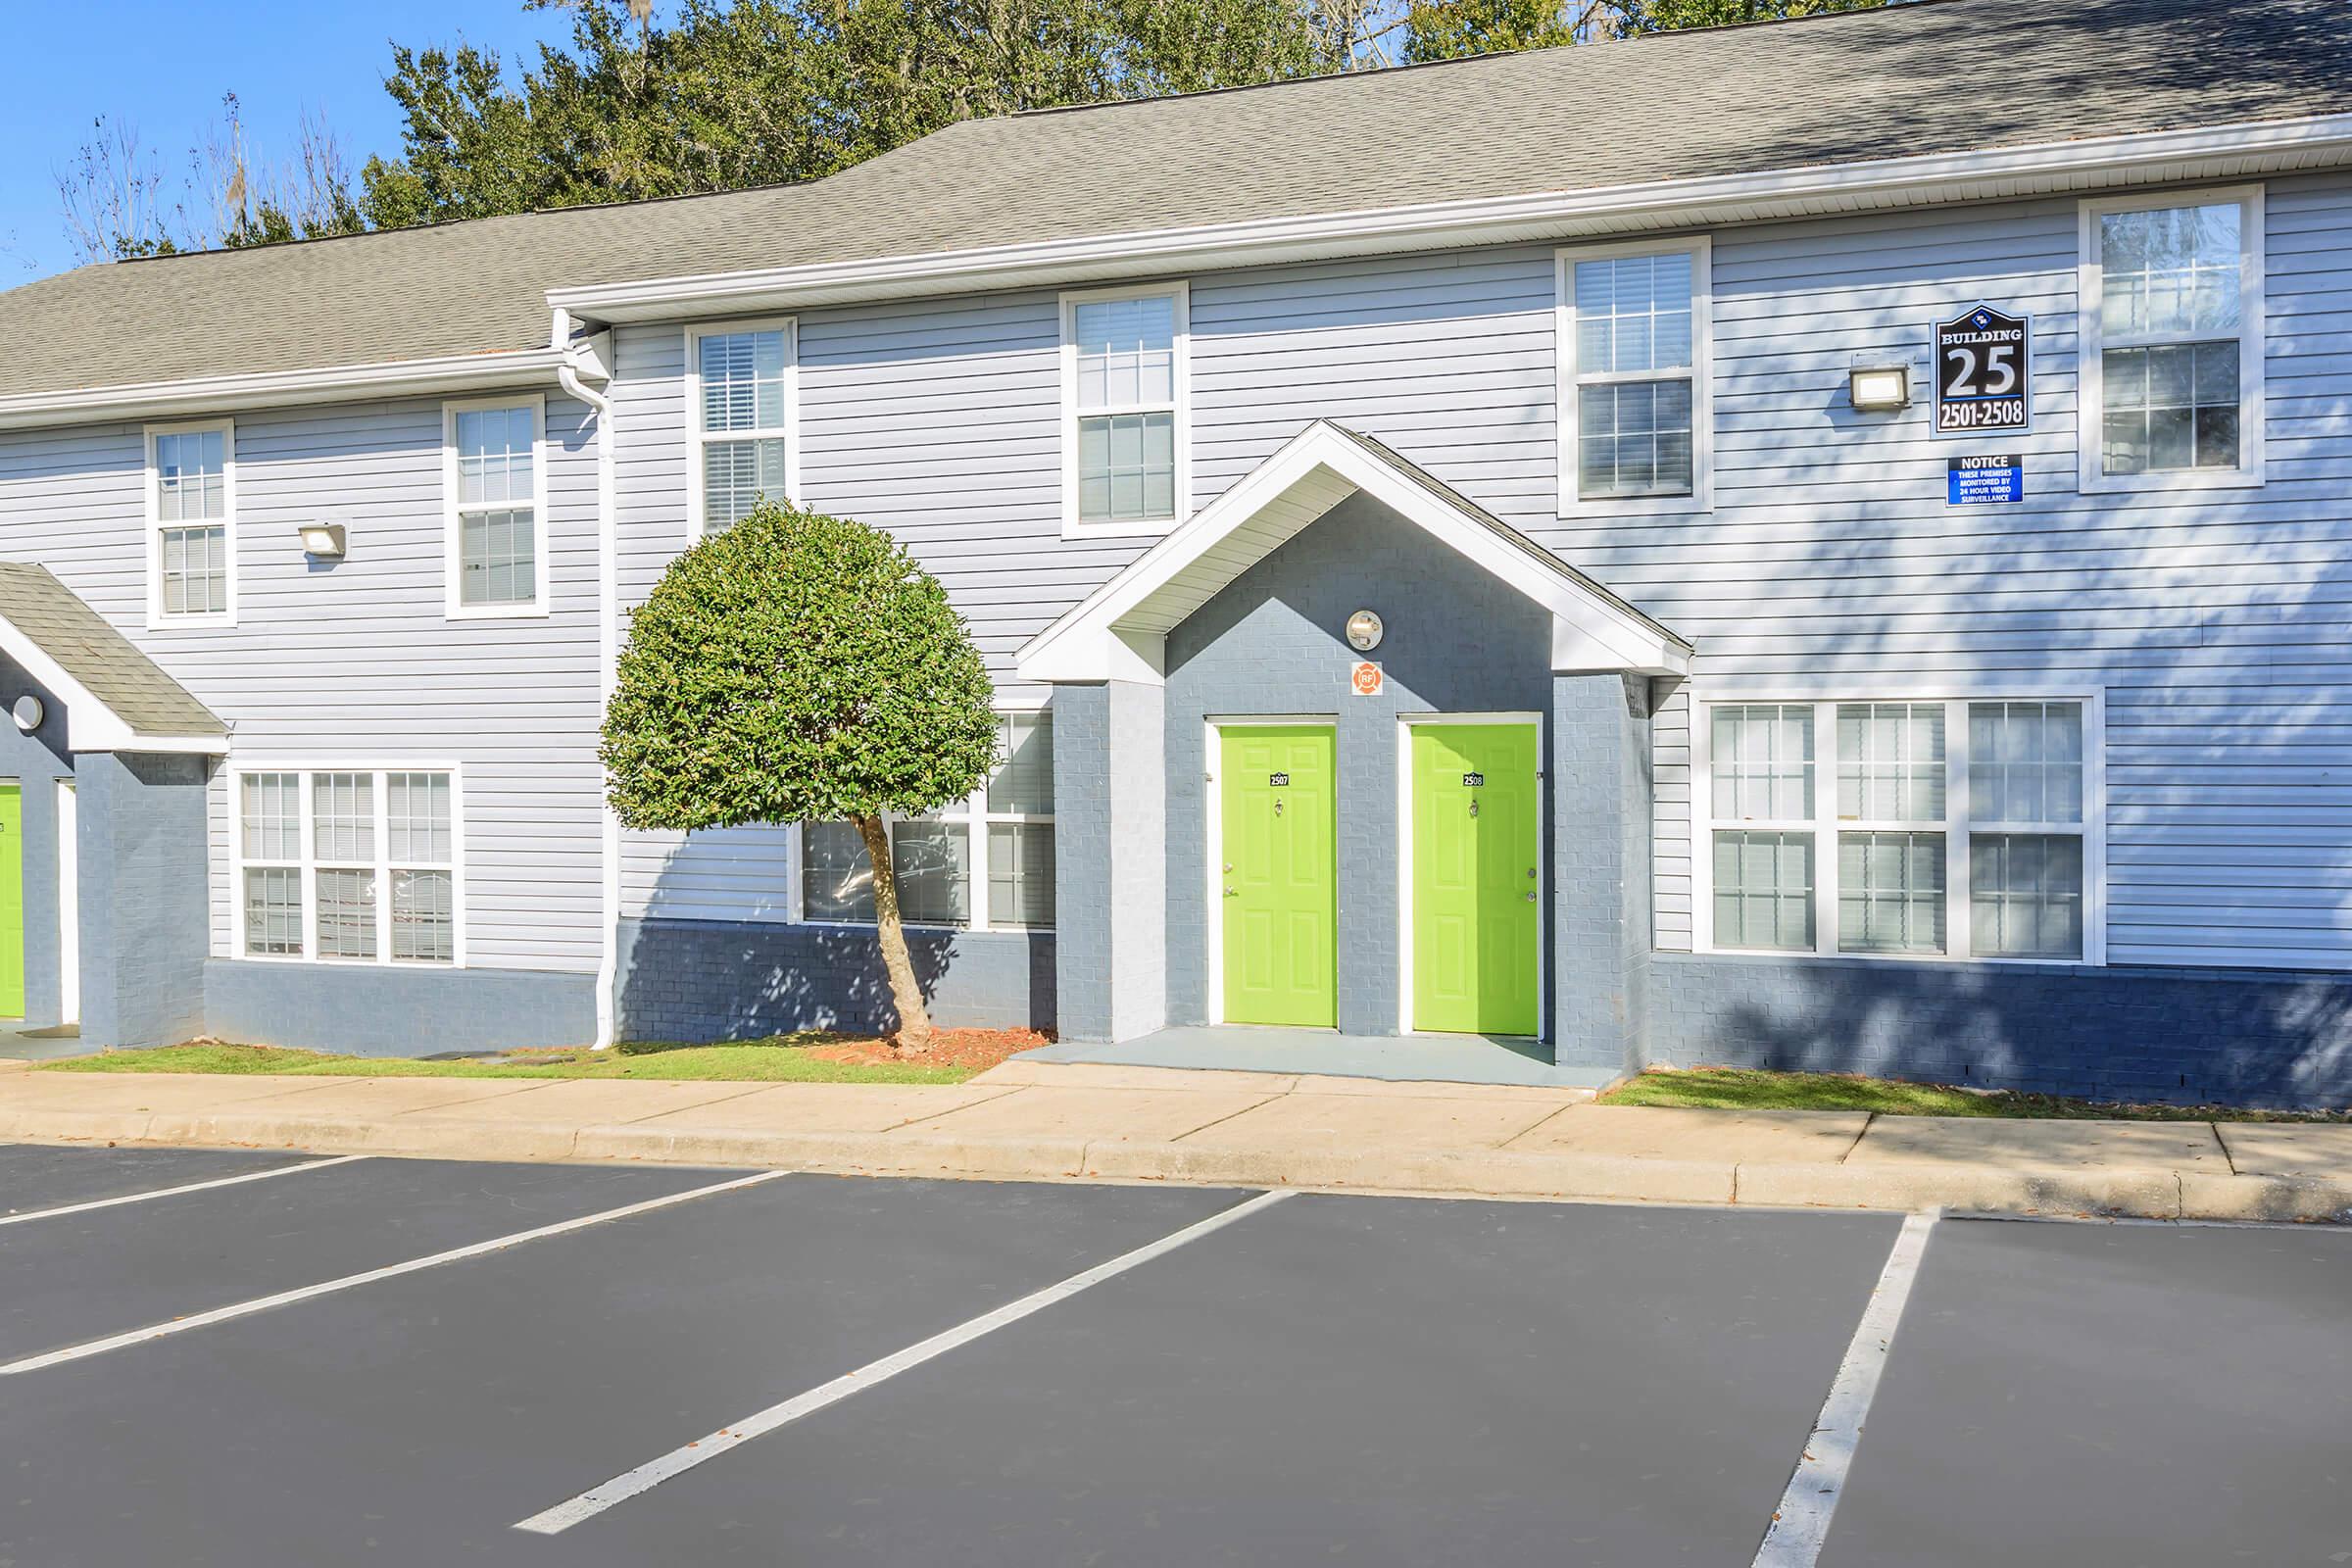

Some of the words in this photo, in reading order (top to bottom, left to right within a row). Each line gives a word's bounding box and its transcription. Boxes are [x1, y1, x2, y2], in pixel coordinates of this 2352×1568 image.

[1940, 329, 2023, 345] BUILDING
[1946, 345, 2016, 397] 25
[1940, 400, 2024, 427] 2501-2508
[1961, 456, 2009, 469] NOTICE
[1958, 470, 1979, 479] THESE
[1980, 468, 2013, 478] PREMISES
[1960, 478, 2000, 487] MONITORED
[1990, 485, 2012, 494] VIDEO
[1961, 494, 2010, 504] SURVEILLANCE
[1362, 674, 1373, 683] RF
[1271, 775, 1288, 785] 2507
[1464, 775, 1483, 786] 2508
